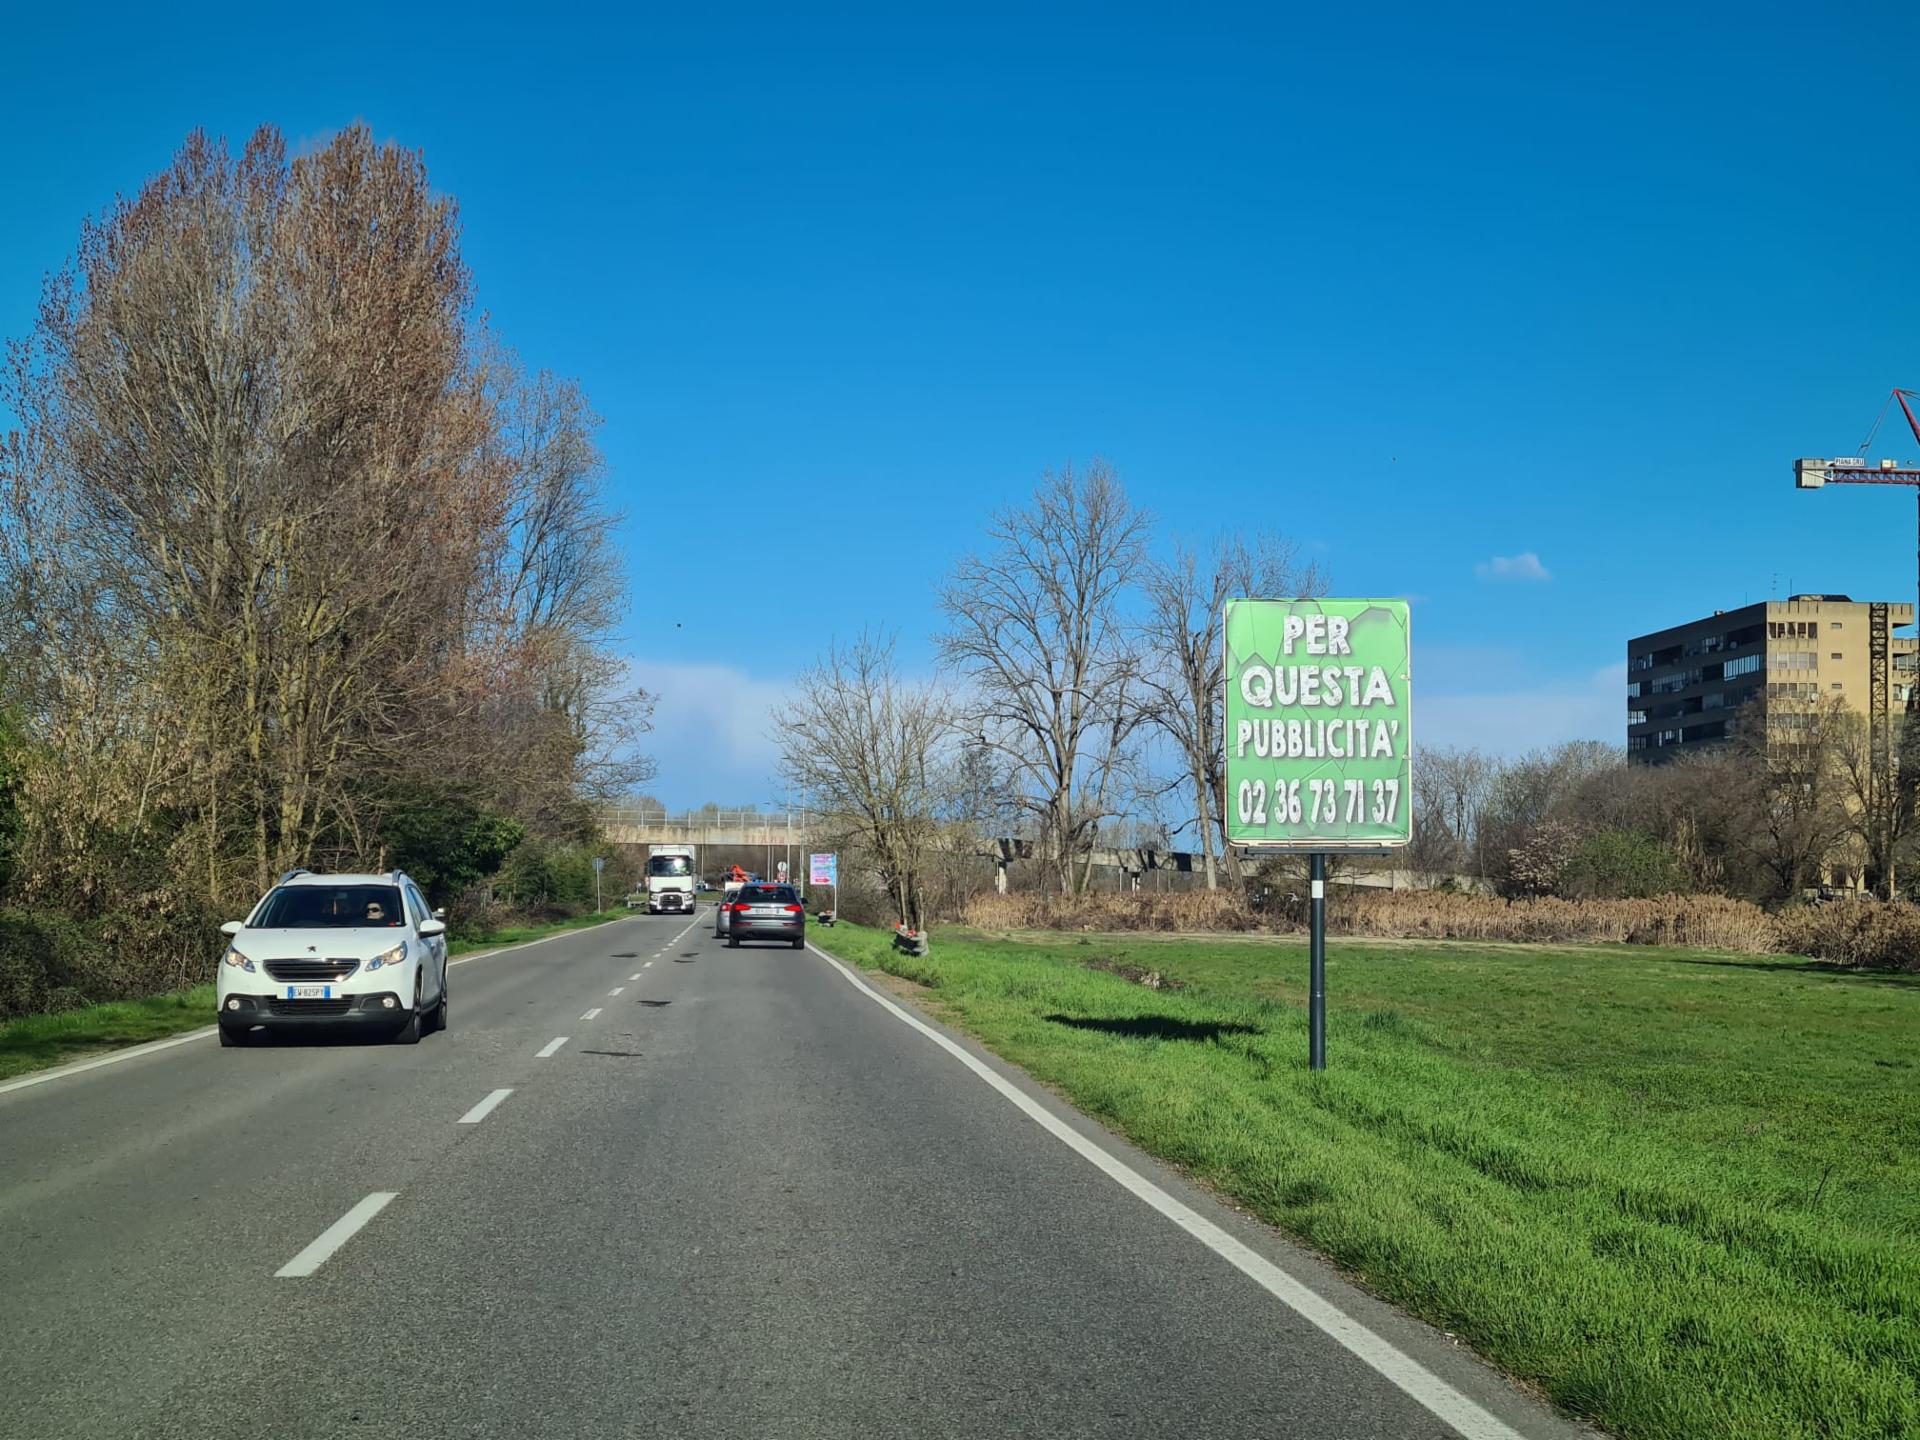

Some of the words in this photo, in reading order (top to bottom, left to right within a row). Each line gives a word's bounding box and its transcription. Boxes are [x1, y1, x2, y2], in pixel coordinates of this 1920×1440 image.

[1283, 614, 1350, 655] PER
[1240, 665, 1395, 708] QUESTA
[1237, 718, 1398, 758] PUBBLICITA'
[1238, 779, 1267, 824] 02
[1274, 779, 1302, 824] 36
[1309, 779, 1337, 824] 73
[1344, 779, 1364, 824] 71
[1372, 779, 1399, 824] 37
